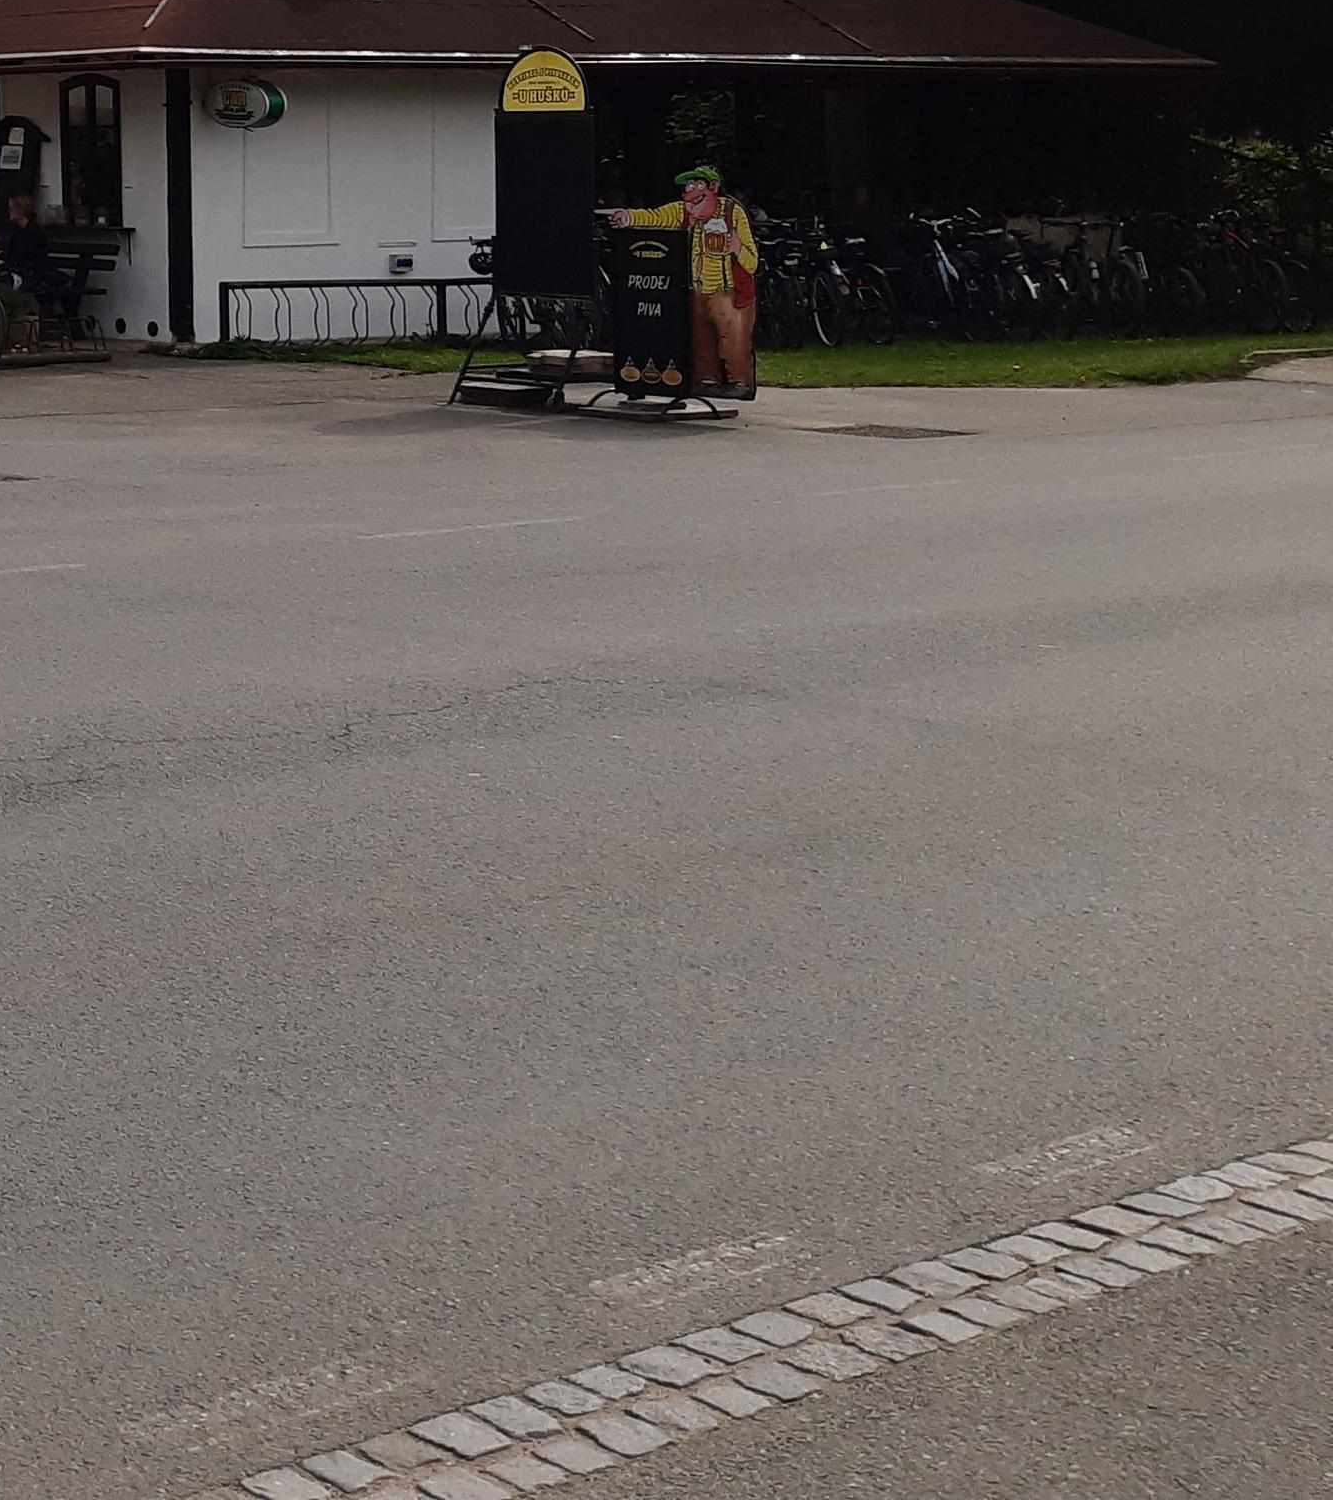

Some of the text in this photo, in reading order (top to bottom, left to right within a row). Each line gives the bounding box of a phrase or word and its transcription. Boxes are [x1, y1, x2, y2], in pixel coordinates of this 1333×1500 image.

[518, 89, 528, 103] U
[627, 274, 671, 290] PRODEJ
[637, 301, 662, 317] PIVA
